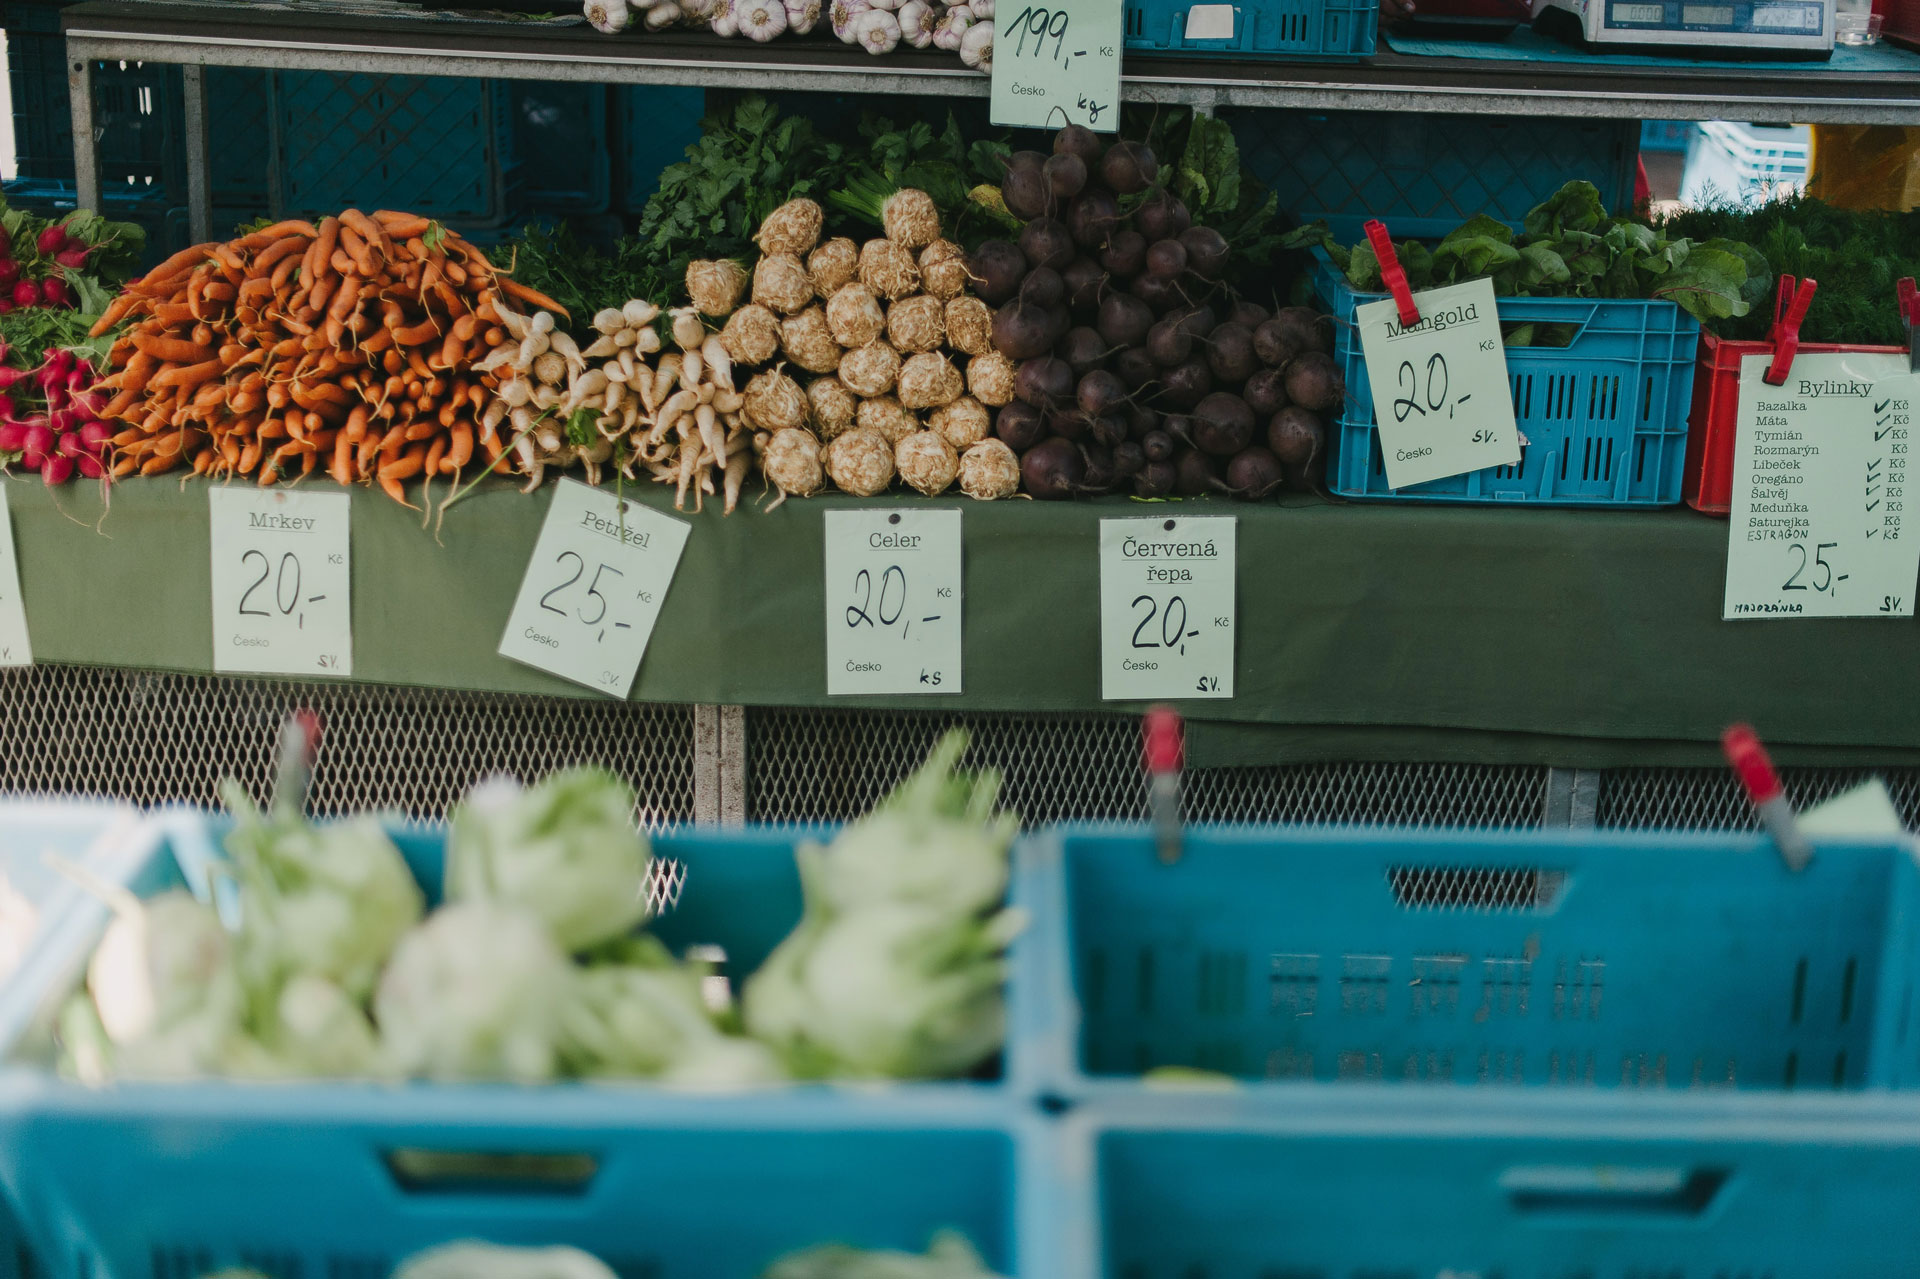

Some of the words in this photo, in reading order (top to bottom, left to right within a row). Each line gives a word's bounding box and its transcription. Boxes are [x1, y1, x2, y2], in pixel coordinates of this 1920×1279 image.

[1004, 6, 1087, 70] 199,-
[1100, 47, 1114, 57] Kč
[1011, 82, 1046, 96] Česko
[1077, 93, 1108, 124] kg
[1479, 341, 1496, 352] Kč
[1394, 353, 1472, 423] 20,-
[1798, 380, 1874, 398] Bylinky
[1756, 401, 1808, 412] Bazalka
[1892, 400, 1909, 410] Kč
[1755, 416, 1788, 426] Máta
[1893, 415, 1910, 425] Kč
[1754, 431, 1803, 443] Tymián
[1891, 429, 1908, 439] Kč
[1396, 447, 1433, 462] Česko
[1753, 445, 1819, 457] Rozmarýn
[1891, 444, 1908, 454] Kč
[1752, 459, 1802, 470] Libeček
[1888, 458, 1906, 468] Kč
[1751, 474, 1804, 486] Oregáno
[1887, 473, 1905, 483] Kč
[1751, 487, 1788, 500] Šalvěj
[1886, 487, 1903, 497] Kč
[1750, 502, 1809, 513] Meduňka
[1886, 501, 1903, 511] Kč
[249, 512, 316, 530] Mrkev
[1748, 517, 1810, 529] Saturejka
[1884, 515, 1901, 526] Kč
[580, 510, 651, 548] Petržel
[1747, 529, 1808, 541] ESTRAGON
[1883, 527, 1900, 540] Kč
[869, 532, 921, 548] Celer
[1122, 536, 1218, 557] Červená
[328, 554, 343, 565] Kč
[1147, 566, 1193, 584] řepa
[1782, 543, 1849, 597] 25,-
[240, 550, 326, 630] 20,-
[541, 551, 631, 643] 25,-
[637, 590, 652, 604] Kč
[937, 588, 952, 598] Kč
[846, 565, 941, 640] 20,-
[1131, 595, 1199, 656] 20,-
[1214, 617, 1229, 627] Kč
[233, 634, 269, 648] Česko
[524, 627, 559, 649] Česko
[846, 660, 882, 672] Česko
[1123, 658, 1158, 671] Česko
[920, 668, 942, 686] ks
